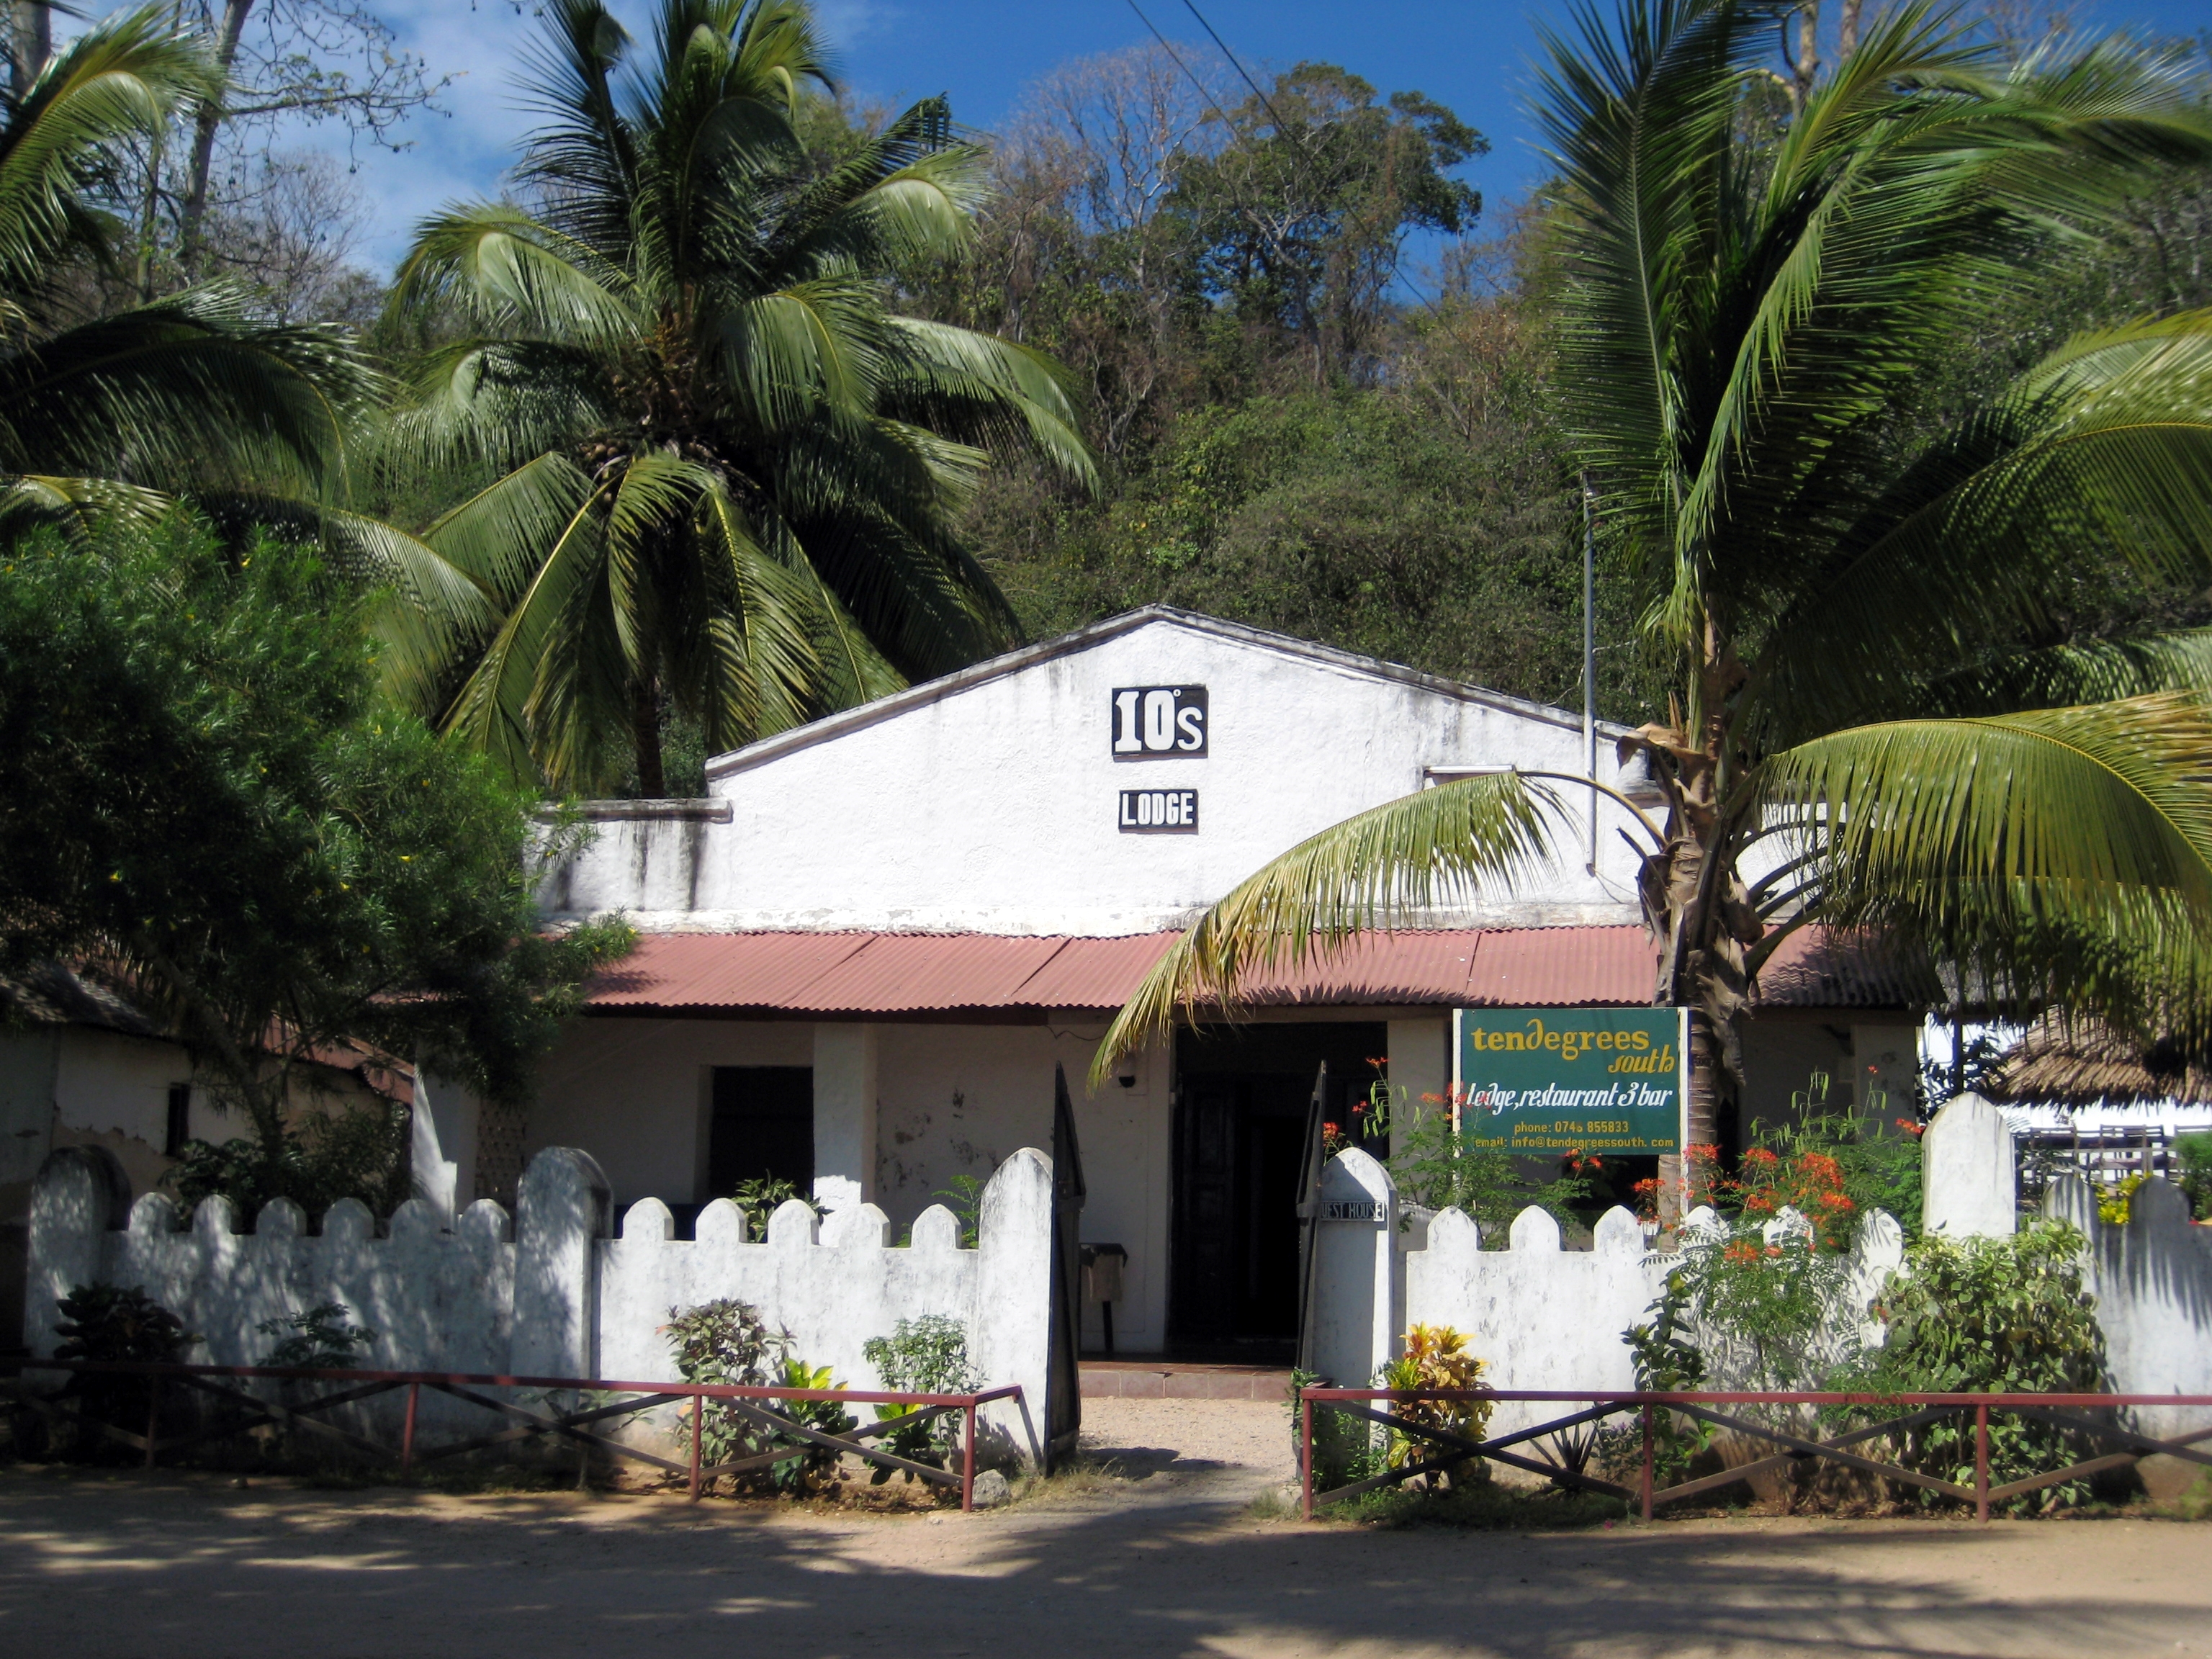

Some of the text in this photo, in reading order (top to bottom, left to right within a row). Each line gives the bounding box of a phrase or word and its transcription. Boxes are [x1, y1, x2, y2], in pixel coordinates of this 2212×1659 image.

[1121, 793, 1193, 825] LODGE
[1471, 1018, 1650, 1061] tendegrees
[1607, 1044, 1676, 1074] south
[1637, 1082, 1673, 1107] bar
[1514, 1121, 1552, 1136] phone:
[1587, 1121, 1629, 1133] 855833
[1475, 1136, 1508, 1147] email:
[1348, 1202, 1381, 1218] HOUSE
